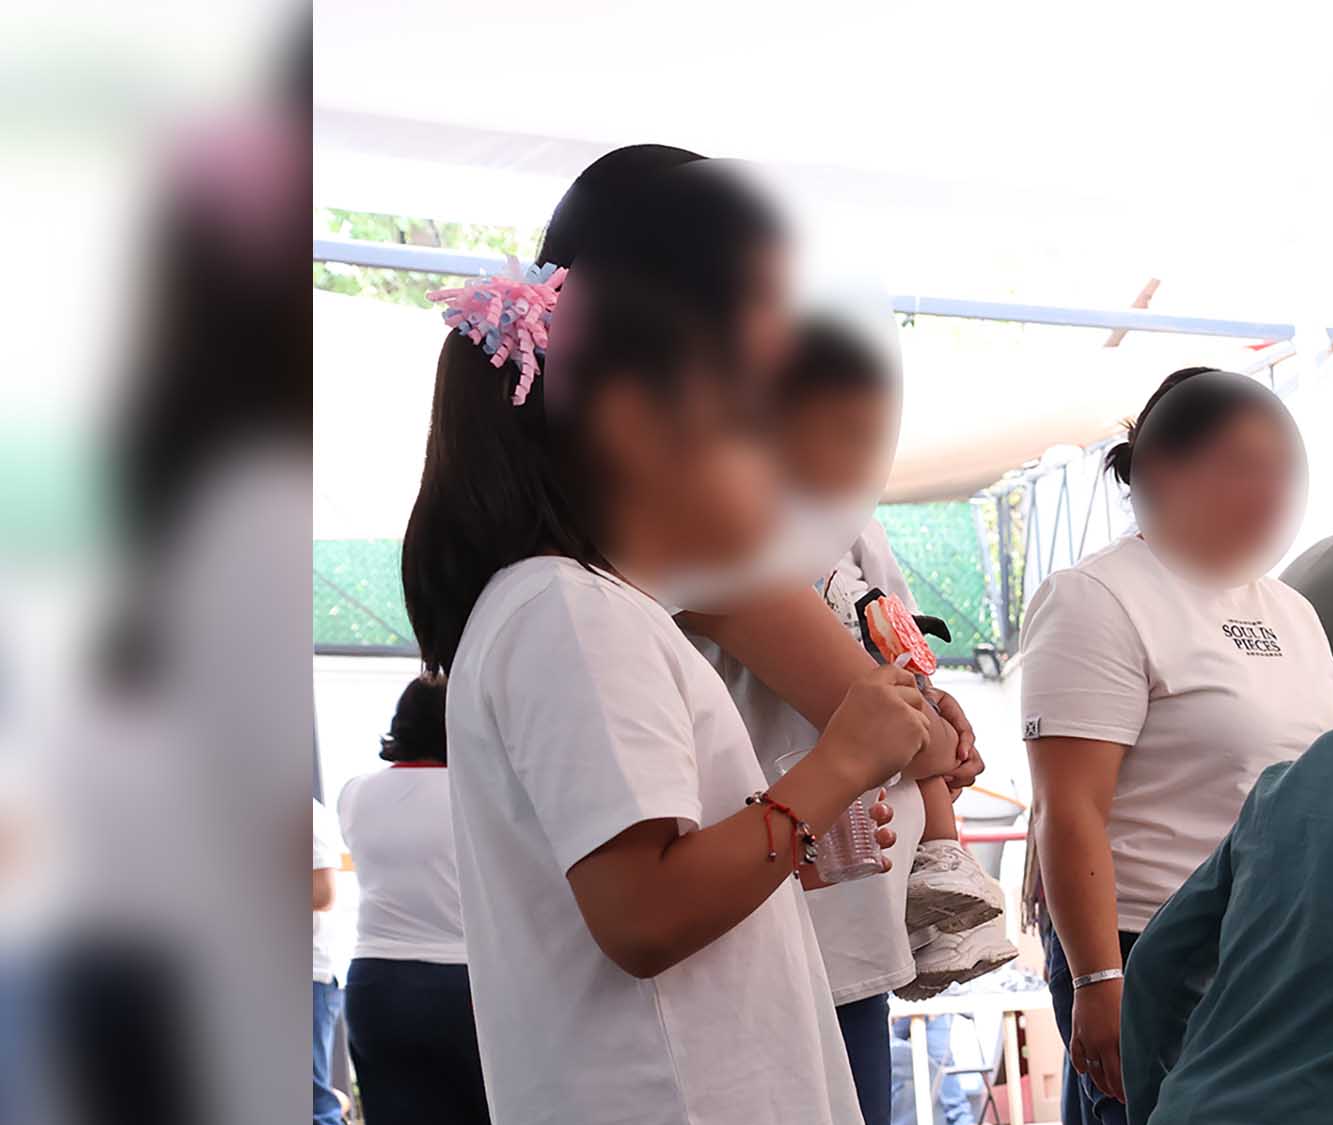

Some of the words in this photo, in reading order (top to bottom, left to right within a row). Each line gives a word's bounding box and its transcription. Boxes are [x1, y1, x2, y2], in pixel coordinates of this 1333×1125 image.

[1222, 624, 1260, 639] SOUL
[1259, 626, 1278, 641] IN
[1233, 638, 1281, 652] PIECES
